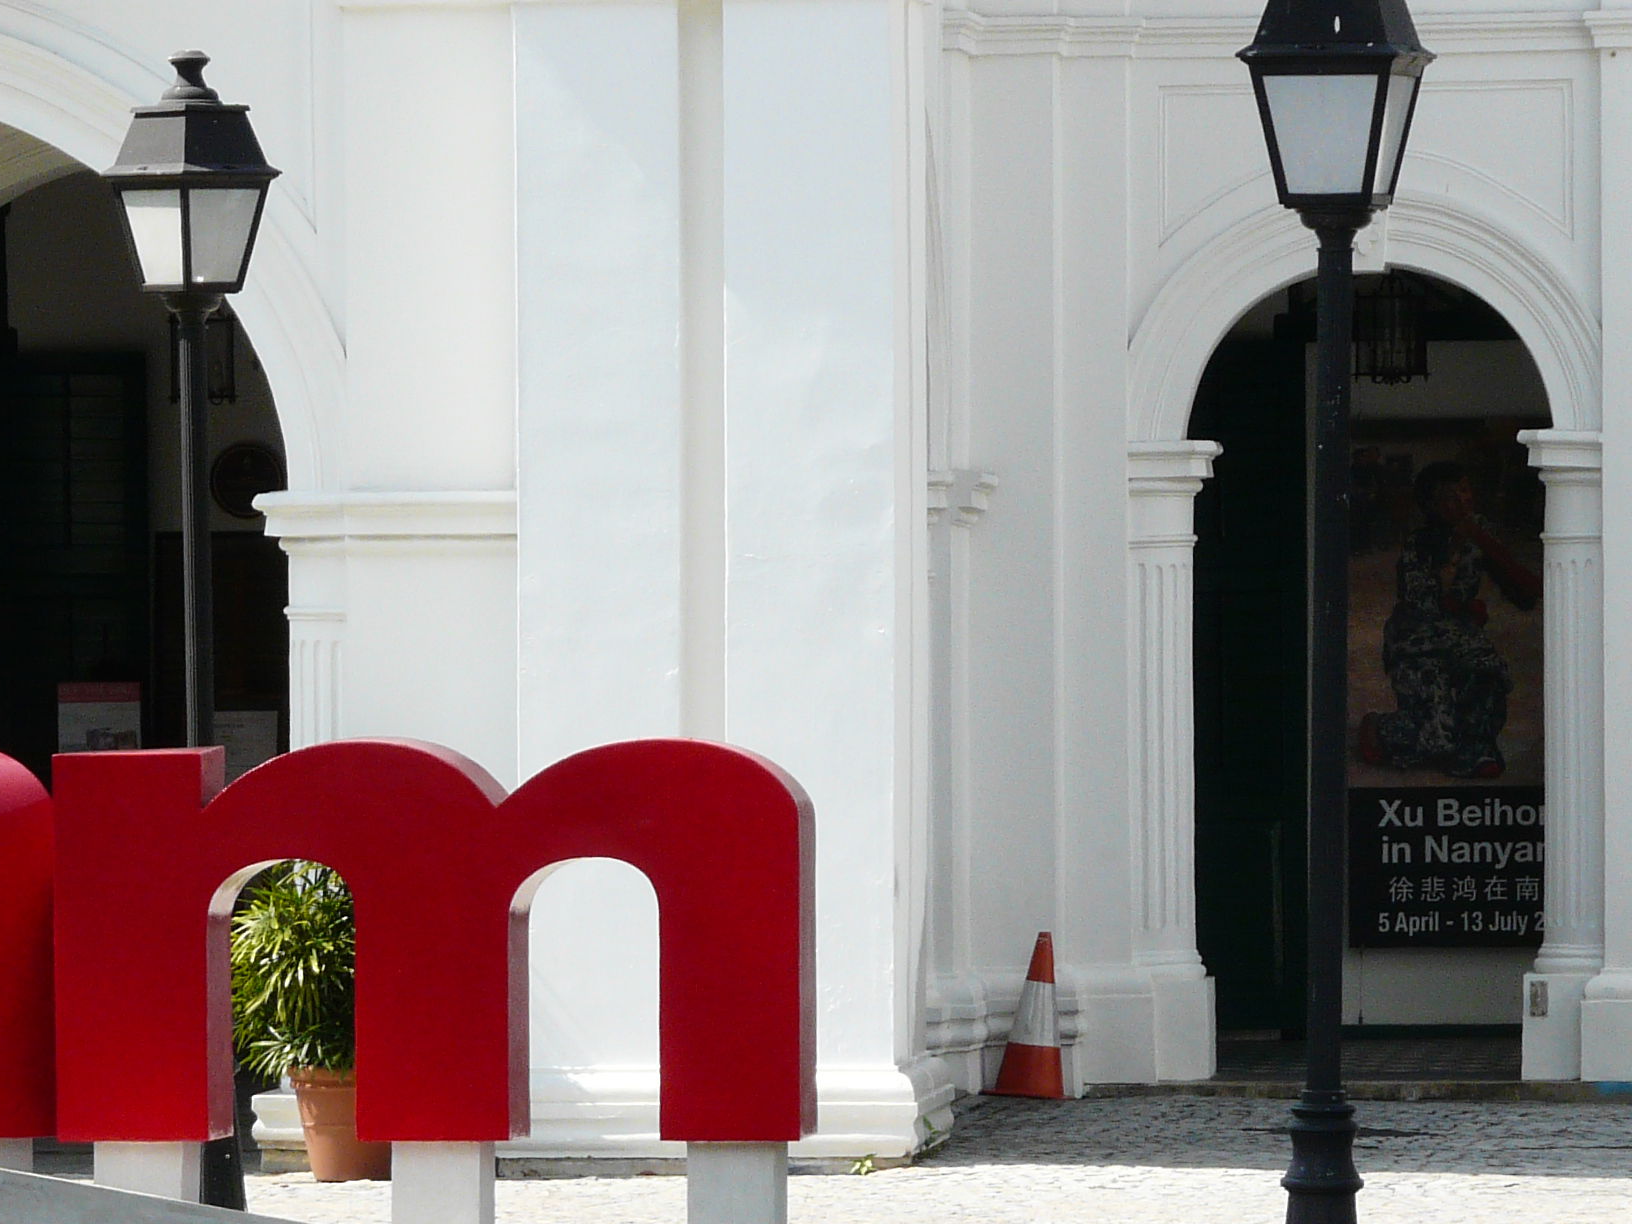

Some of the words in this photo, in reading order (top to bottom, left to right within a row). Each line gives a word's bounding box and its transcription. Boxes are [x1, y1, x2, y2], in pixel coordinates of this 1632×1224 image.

[1378, 800, 1424, 827] Xu
[1382, 836, 1411, 864] in
[1379, 912, 1390, 932] 5
[1395, 912, 1439, 936] April
[1460, 911, 1483, 932] 13
[1489, 911, 1528, 936] July
